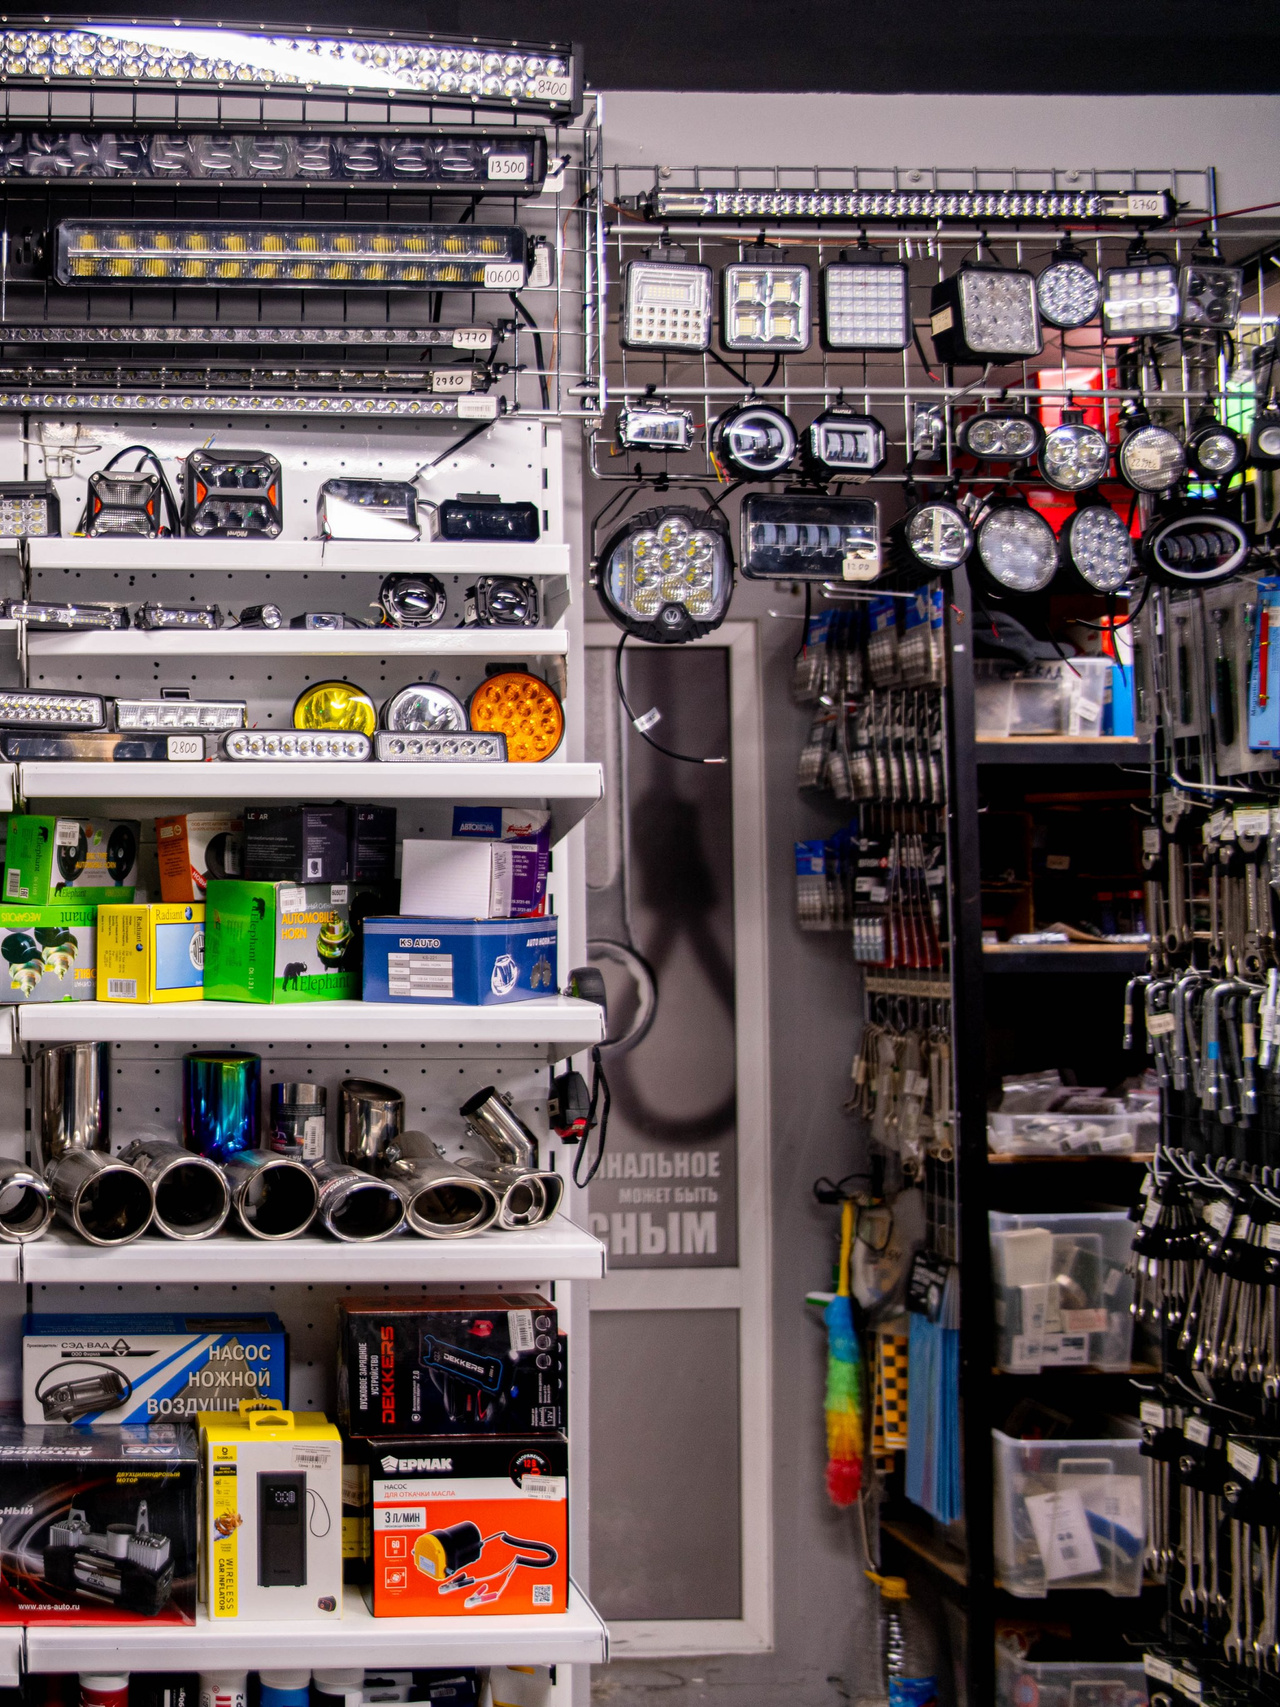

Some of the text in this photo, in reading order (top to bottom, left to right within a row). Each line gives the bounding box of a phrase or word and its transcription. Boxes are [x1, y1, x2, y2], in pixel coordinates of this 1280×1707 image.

[538, 80, 568, 95] 8700
[491, 160, 525, 173] 13500
[1132, 200, 1157, 211] 2760
[486, 270, 520, 283] 10600
[457, 333, 487, 343] 3770
[435, 376, 464, 386] 2980
[172, 741, 198, 754] 2800
[62, 889, 87, 900] Elephant
[155, 908, 183, 920] Radiant
[281, 911, 334, 925] AUTOMOBILE
[248, 910, 259, 962] Elephant
[281, 927, 307, 940] HORN
[399, 938, 441, 948] KS AUTO
[299, 973, 350, 995] Elephant
[592, 1151, 721, 1179] ИНАЛЬНОЕ
[619, 1186, 718, 1204] МОЖЕТ БЫТЬ
[589, 1211, 718, 1255] СНЫМ
[61, 1341, 110, 1350] СЭД-ВАД
[208, 1344, 271, 1361] НАСОС
[443, 1353, 485, 1375] DEKKERS
[188, 1368, 270, 1387] НОЖНОЙ
[358, 1342, 368, 1411] ПУСКОВОЕ ЗАРЯДНОЕ
[370, 1354, 379, 1396] УСТРОЙСТВО
[380, 1325, 396, 1424] DEKKERS
[412, 1370, 420, 1380] 2.0
[147, 1394, 270, 1417] ВОЗДУШН
[398, 1458, 453, 1471] ЕРМАК
[524, 1458, 532, 1468] 12
[385, 1511, 420, 1523] 3 Л/МИН
[391, 1540, 400, 1549] 60
[226, 1558, 234, 1610] WIRELESS
[18, 1603, 80, 1611] www.avs-auto.ru
